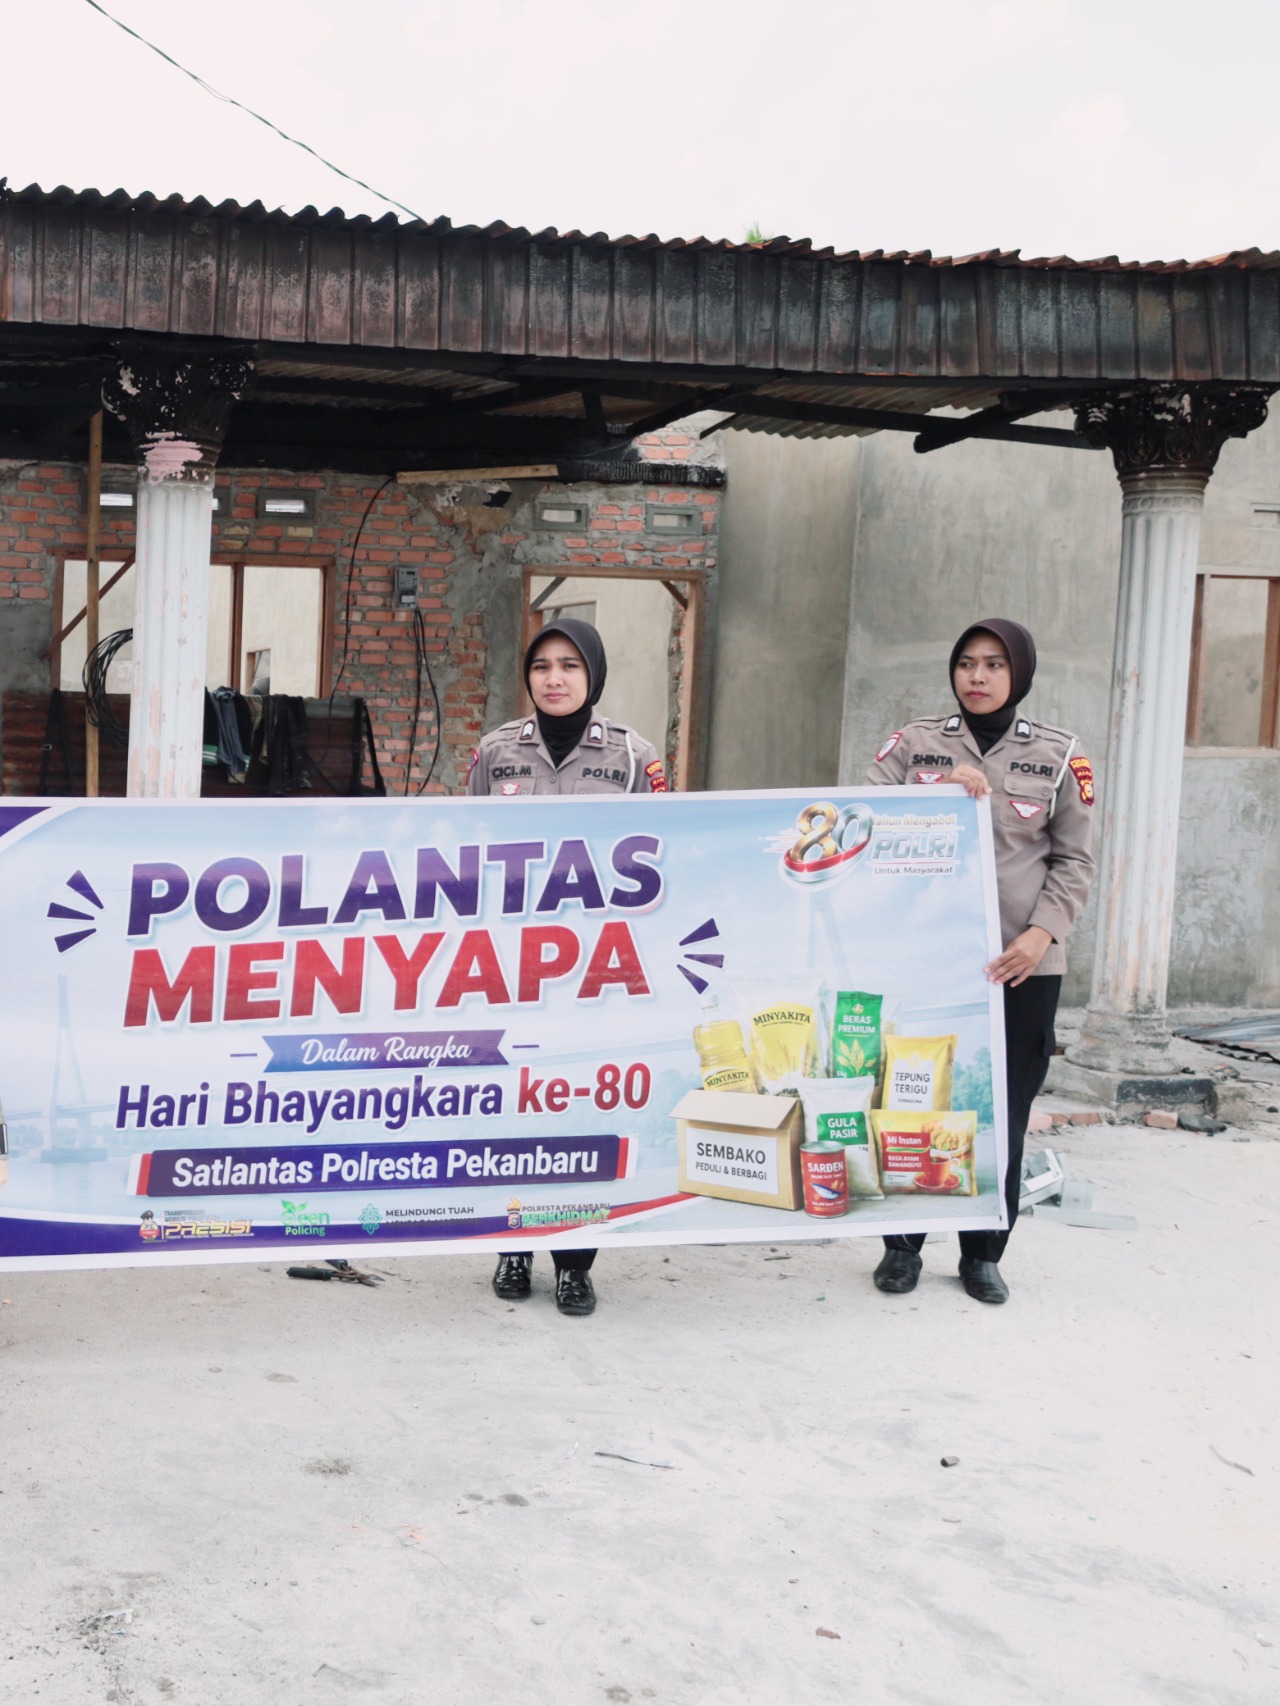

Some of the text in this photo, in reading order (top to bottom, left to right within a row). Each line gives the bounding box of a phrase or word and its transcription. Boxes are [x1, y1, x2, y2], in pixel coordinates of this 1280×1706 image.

[911, 754, 953, 767] SHINTA
[492, 765, 532, 779] CICI.M
[582, 767, 626, 781] POLRI
[1009, 761, 1054, 777] POLRI
[872, 815, 956, 828] Tahun Mengabdi
[789, 802, 873, 865] 80
[872, 834, 956, 859] POLRI
[874, 866, 953, 876] Untuk Masyarakat
[126, 835, 663, 936] POLANTAS
[123, 921, 652, 1028] MENYAPA
[753, 1011, 811, 1026] MINYAKITA
[842, 1014, 872, 1024] BERAS
[837, 1024, 876, 1034] PREMIUM
[300, 1038, 472, 1068] Dalam Rangka
[706, 1071, 750, 1088] MINYAKITA
[895, 1072, 930, 1082] TEPUNG
[895, 1084, 928, 1094] TERIGU
[118, 1062, 651, 1133] Hari Bhayangkara ke-80
[827, 1117, 857, 1128] GULA
[829, 1129, 858, 1139] PASIR
[886, 1135, 922, 1145] Mi Instan
[696, 1142, 766, 1165] SEMBAKO
[172, 1144, 599, 1188] Satlantas Polresta Pekanbaru
[696, 1161, 767, 1180] PEDULI & BERBAGI
[807, 1161, 843, 1173] SARDEN
[385, 1206, 474, 1217] MELINDUNGI TUAH
[563, 1203, 611, 1211] PEKANBARU
[165, 1220, 252, 1236] PRESISI
[285, 1225, 326, 1237] Policing
